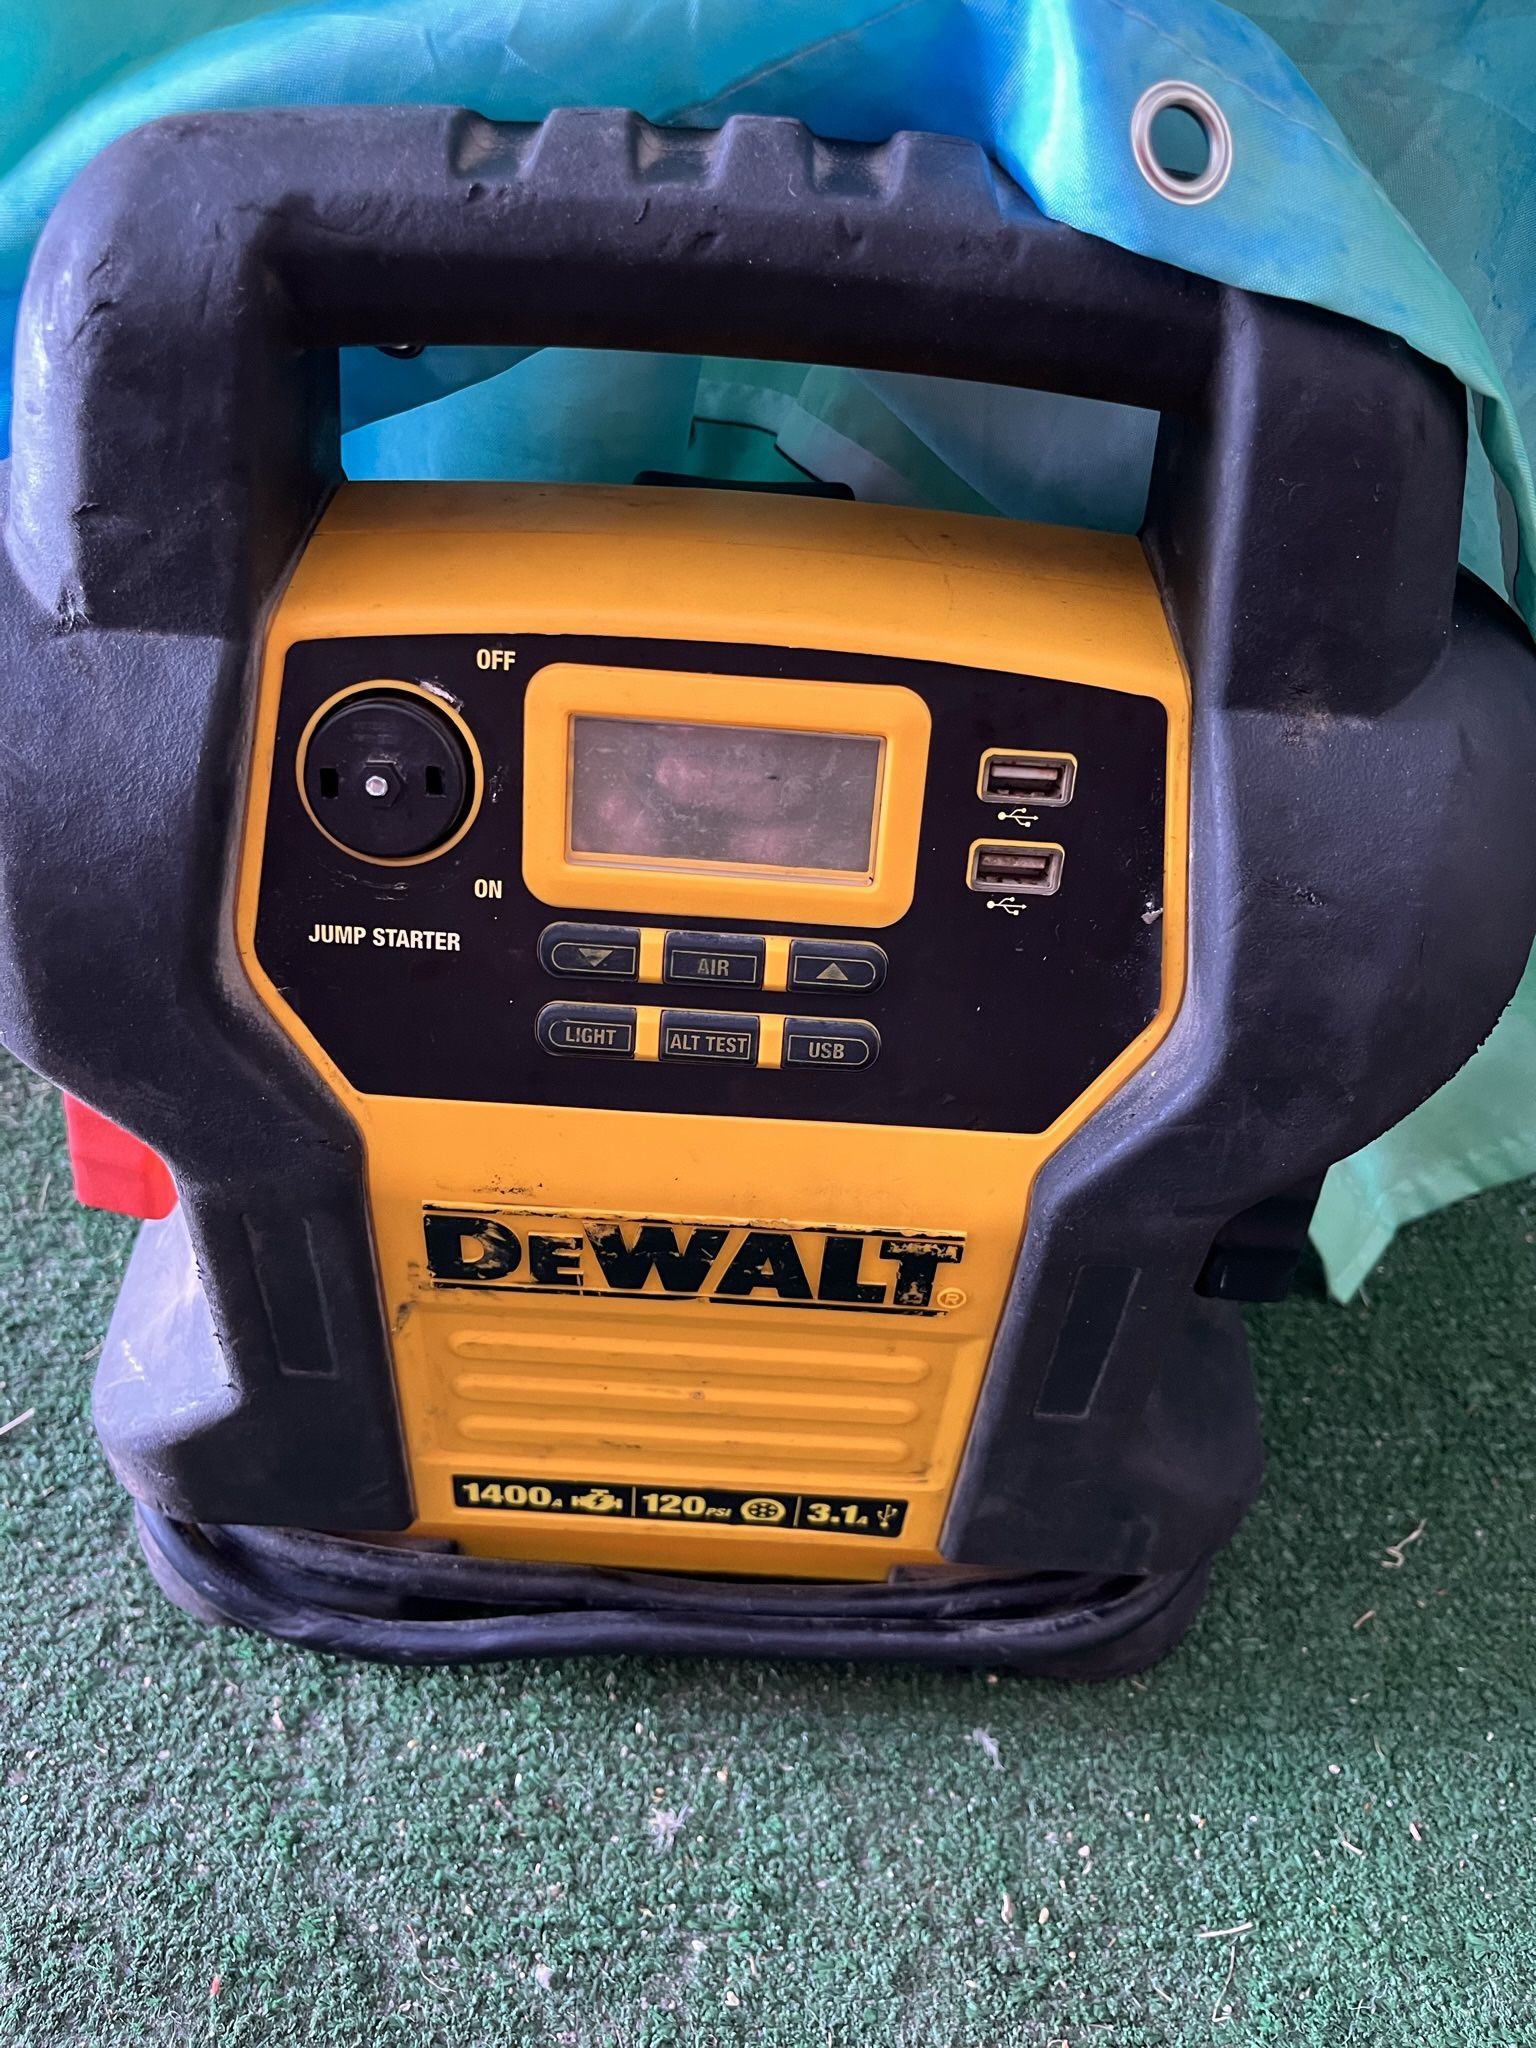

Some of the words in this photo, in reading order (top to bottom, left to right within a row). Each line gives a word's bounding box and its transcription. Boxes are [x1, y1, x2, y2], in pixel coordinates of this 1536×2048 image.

[476, 648, 516, 671] OFF
[474, 879, 503, 899] ON
[308, 924, 367, 945] JUMP
[372, 928, 461, 951] STARTER
[697, 957, 730, 977] AIR
[565, 1026, 617, 1046] LIGHT
[669, 1033, 701, 1051] ALT
[705, 1036, 748, 1054] TEST
[808, 1042, 845, 1060] USB
